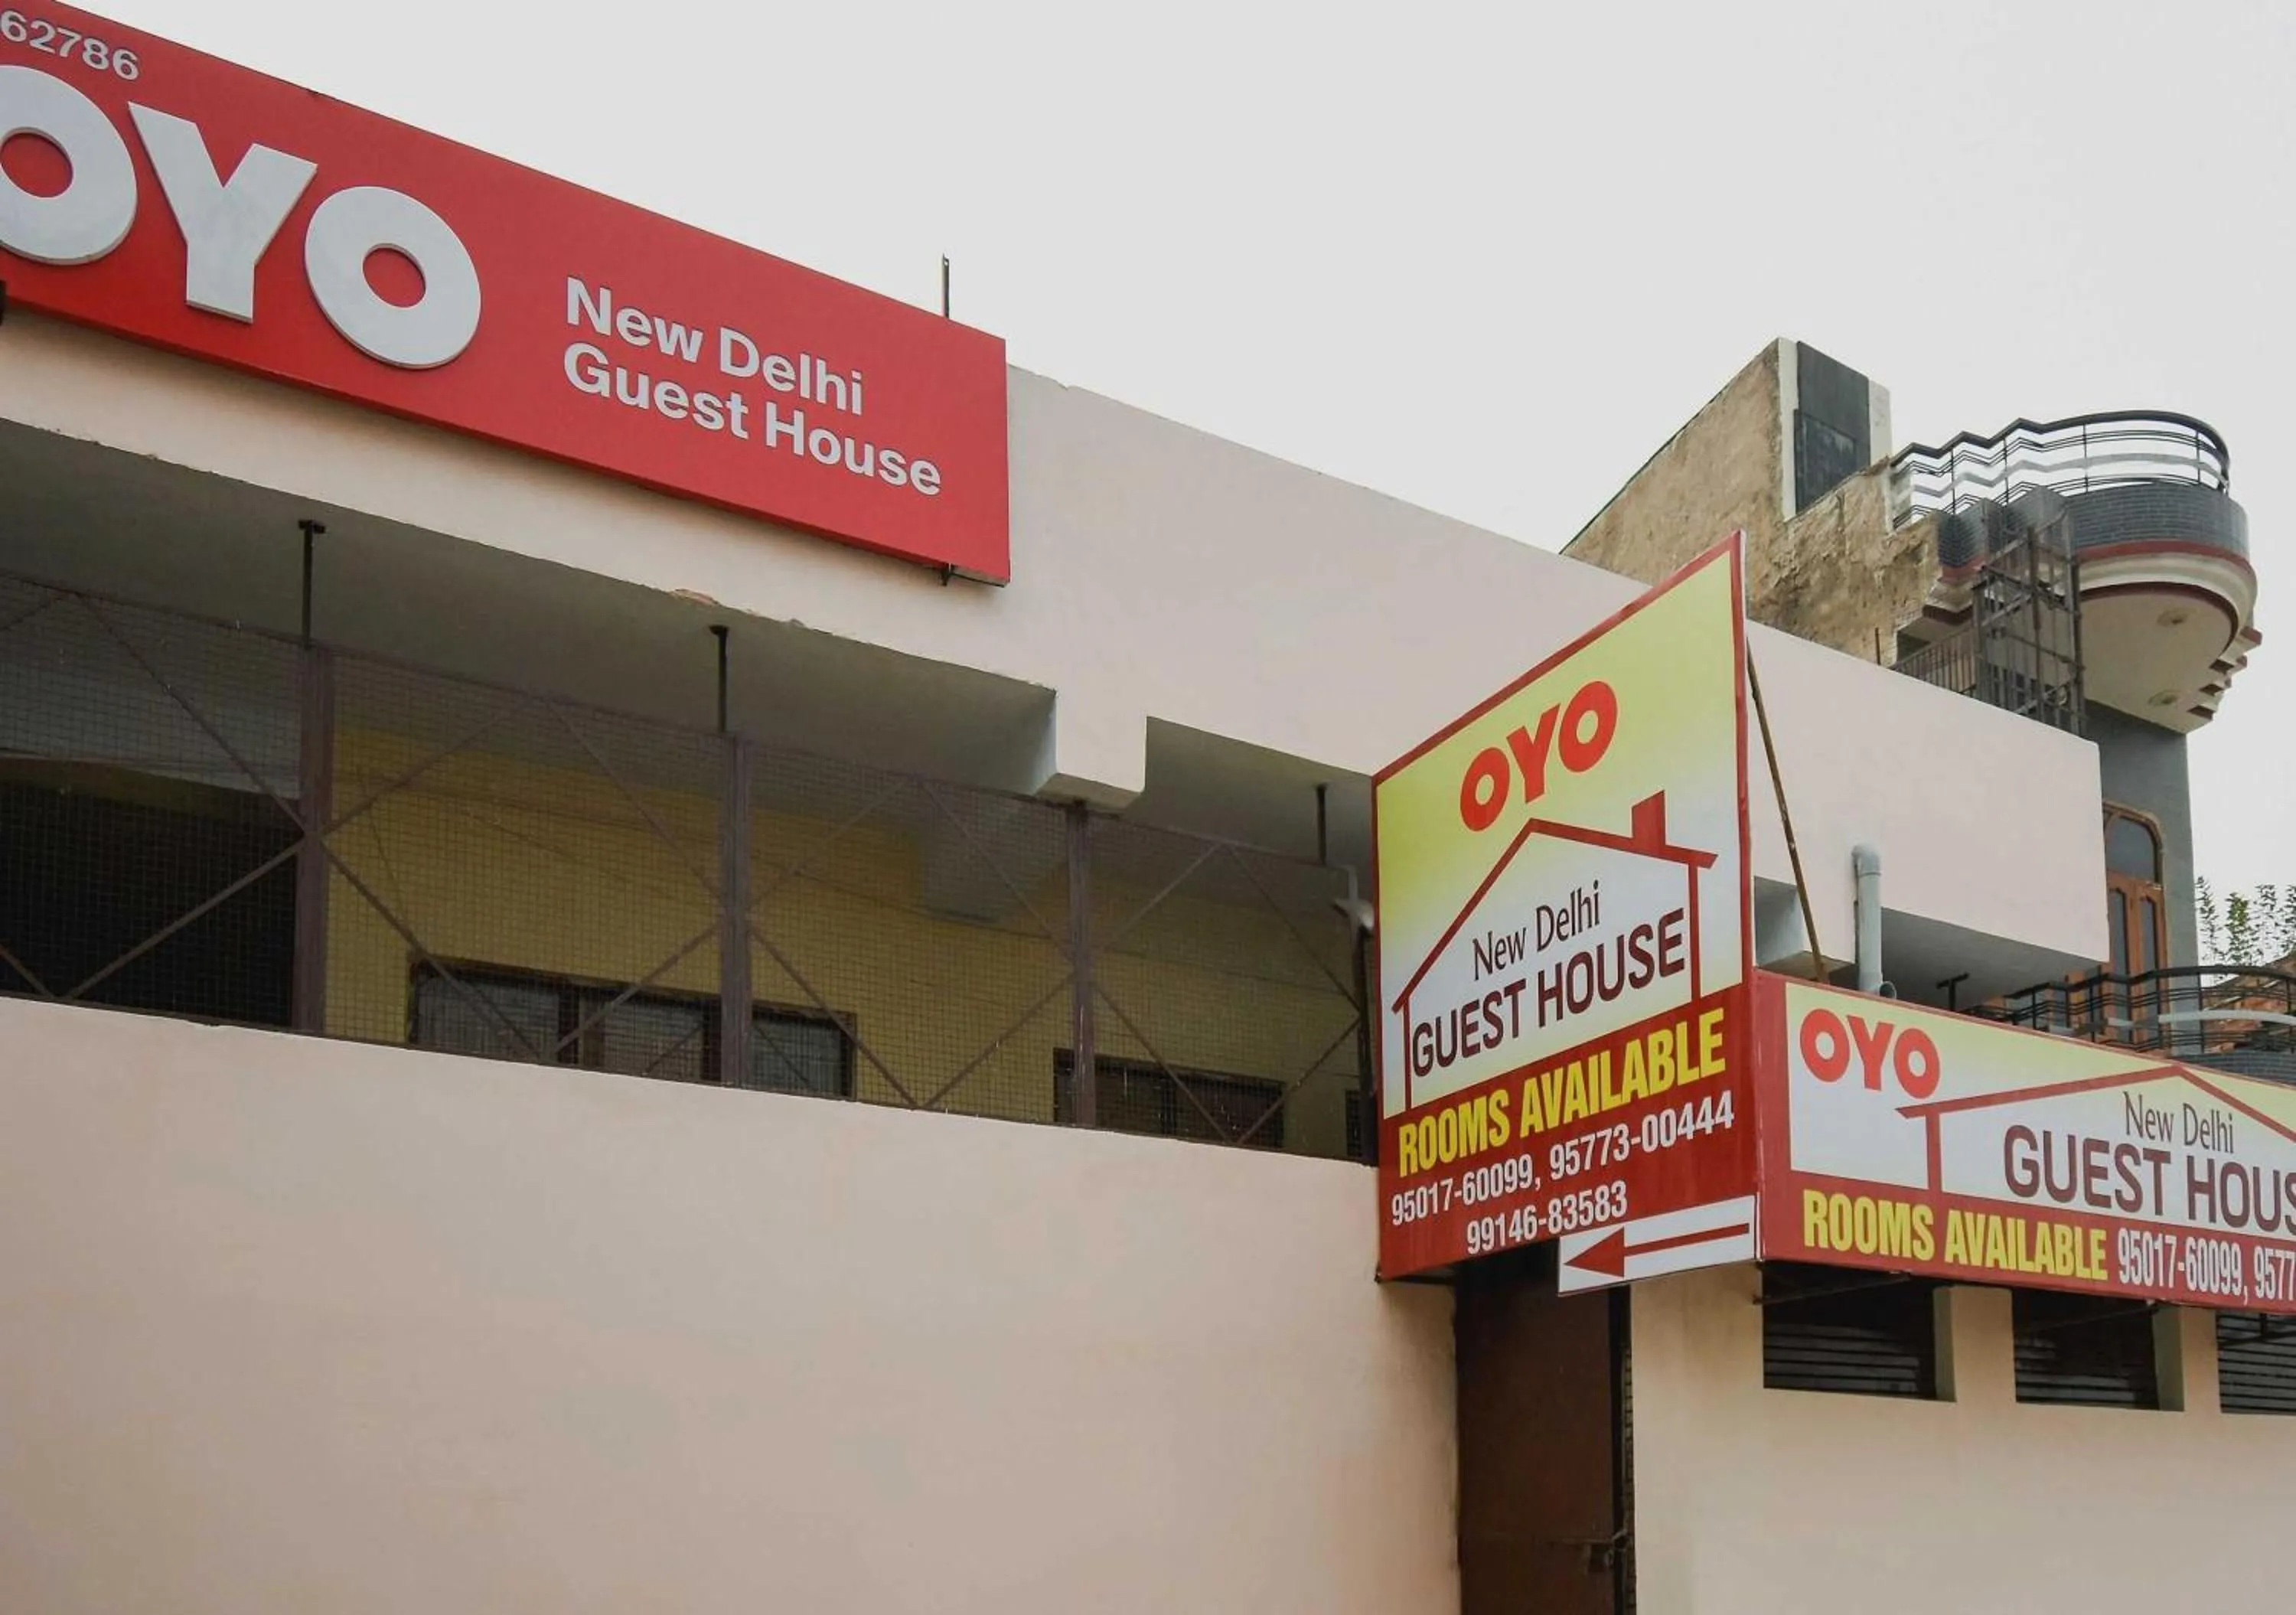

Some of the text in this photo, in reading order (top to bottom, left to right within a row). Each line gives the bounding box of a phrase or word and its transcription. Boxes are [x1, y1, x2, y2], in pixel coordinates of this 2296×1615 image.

[2, 10, 139, 80] 62786
[0, 64, 481, 370] OYO
[566, 276, 863, 416] New Delhi
[563, 343, 941, 496] Guest House
[1459, 680, 1617, 831] OYO
[1412, 907, 1684, 1077] GUEST HOUSE
[1473, 879, 1600, 980] New Delhi
[1399, 1008, 1726, 1177] ROOMS AVAILABLE
[1800, 1008, 1941, 1098] OYO
[1392, 1090, 1735, 1226] 95017-60099, 95773-00444
[2004, 1125, 2171, 1215] GUEST
[2123, 1091, 2235, 1153] New Delhi
[1466, 1181, 1628, 1254] 99146-83583
[1803, 1189, 2296, 1306] ROOMS AVAILABLE 95017-60099, 9577
